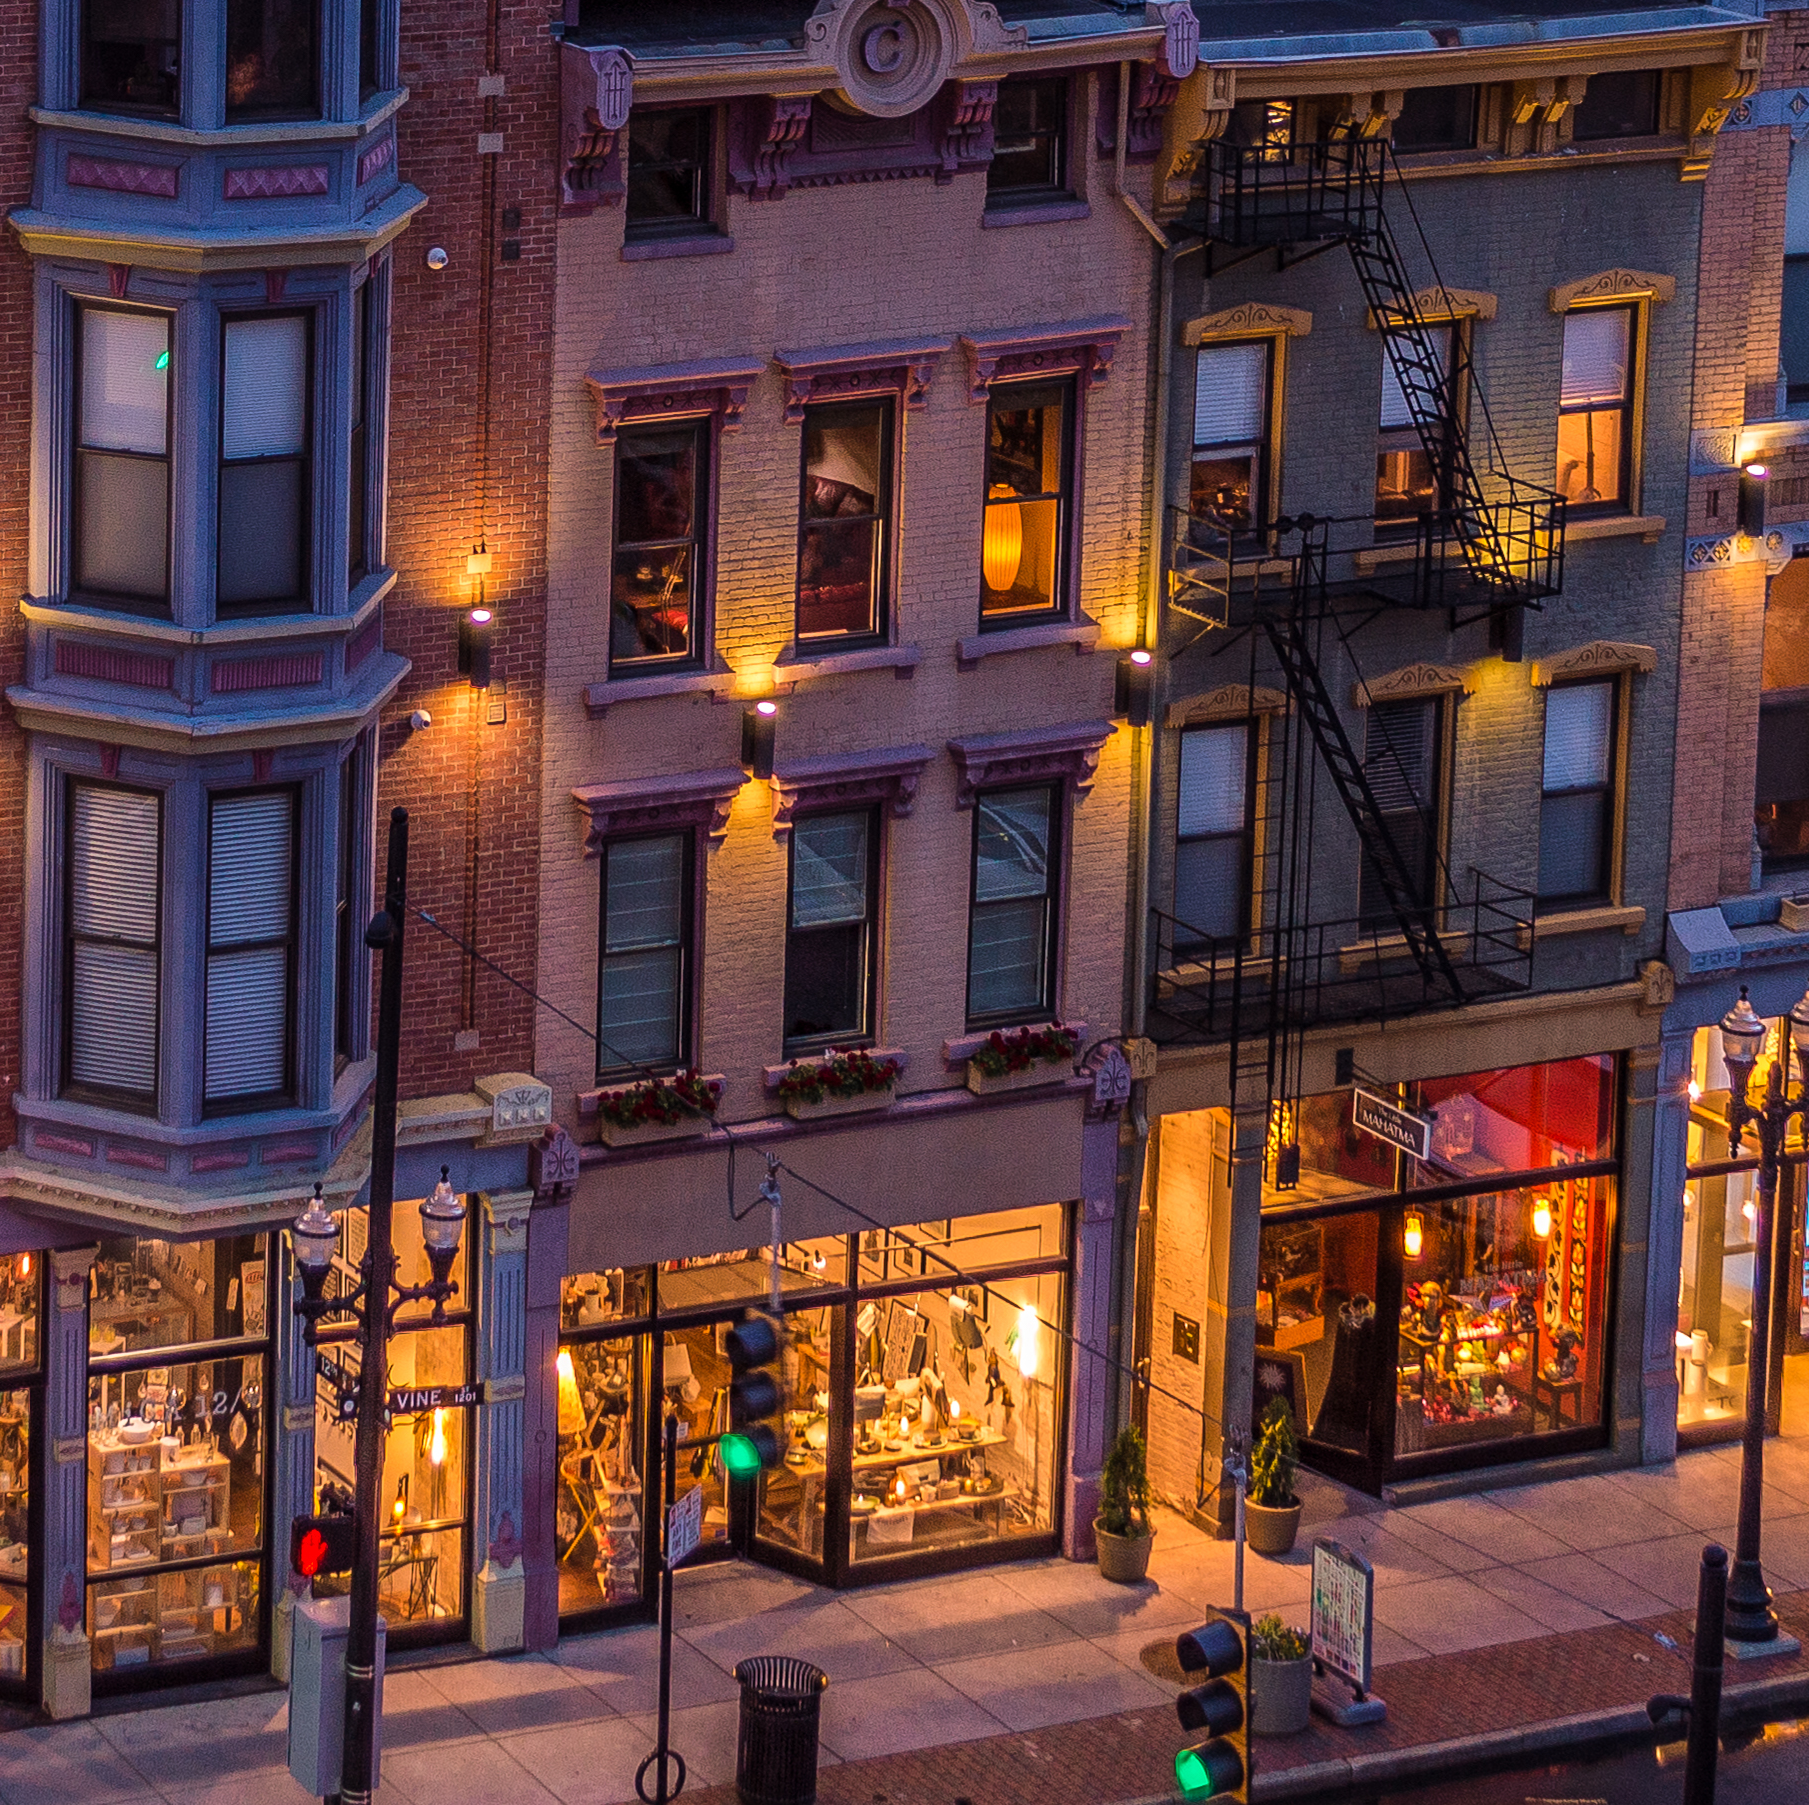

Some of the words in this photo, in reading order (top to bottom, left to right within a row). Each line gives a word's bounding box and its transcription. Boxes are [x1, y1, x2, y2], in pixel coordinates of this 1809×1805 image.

[1363, 1109, 1416, 1148] MAHATMA
[397, 1389, 442, 1409] VINE
[454, 1392, 477, 1404] 1201
